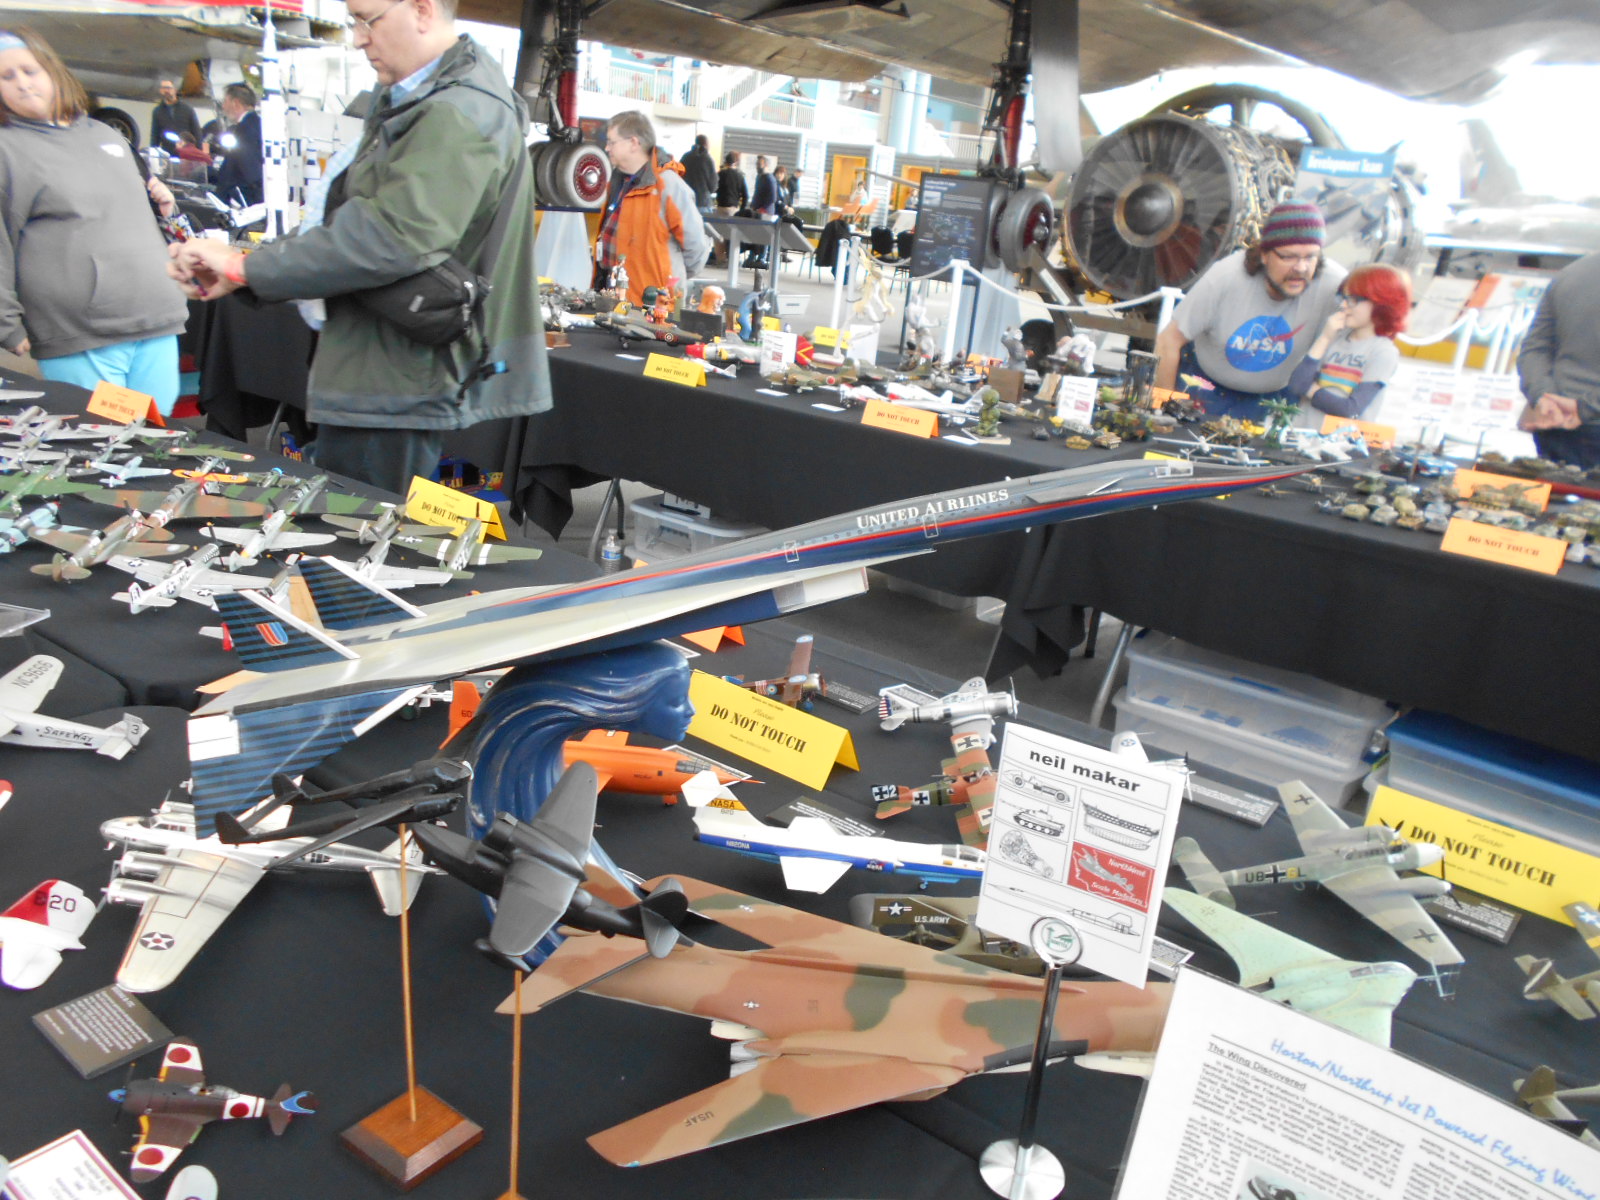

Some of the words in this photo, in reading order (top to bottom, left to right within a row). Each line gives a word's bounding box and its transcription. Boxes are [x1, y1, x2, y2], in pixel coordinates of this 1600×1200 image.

[1361, 158, 1384, 174] Team
[1231, 335, 1287, 355] NASA
[856, 506, 920, 529] UNITED
[925, 488, 1009, 515] AIRLINES
[1484, 538, 1503, 548] NOT
[1507, 544, 1540, 556] TOUCH
[710, 704, 728, 720] DO
[730, 712, 758, 732] NOT
[761, 724, 808, 753] TOUCH
[1030, 750, 1066, 770] neil
[1072, 763, 1141, 792] makar
[711, 799, 734, 808] NASA
[888, 784, 898, 798] 2
[1410, 826, 1436, 844] DO
[1442, 836, 1482, 860] NOT
[1488, 852, 1556, 887] TOUCH
[1208, 1042, 1226, 1056] The
[1226, 1050, 1251, 1068] Wing
[1253, 1060, 1308, 1090] Discovered
[684, 1110, 714, 1128] USAF
[1398, 1096, 1422, 1115] Jet
[1424, 1105, 1488, 1146] Powered
[1490, 1140, 1548, 1182] Flying
